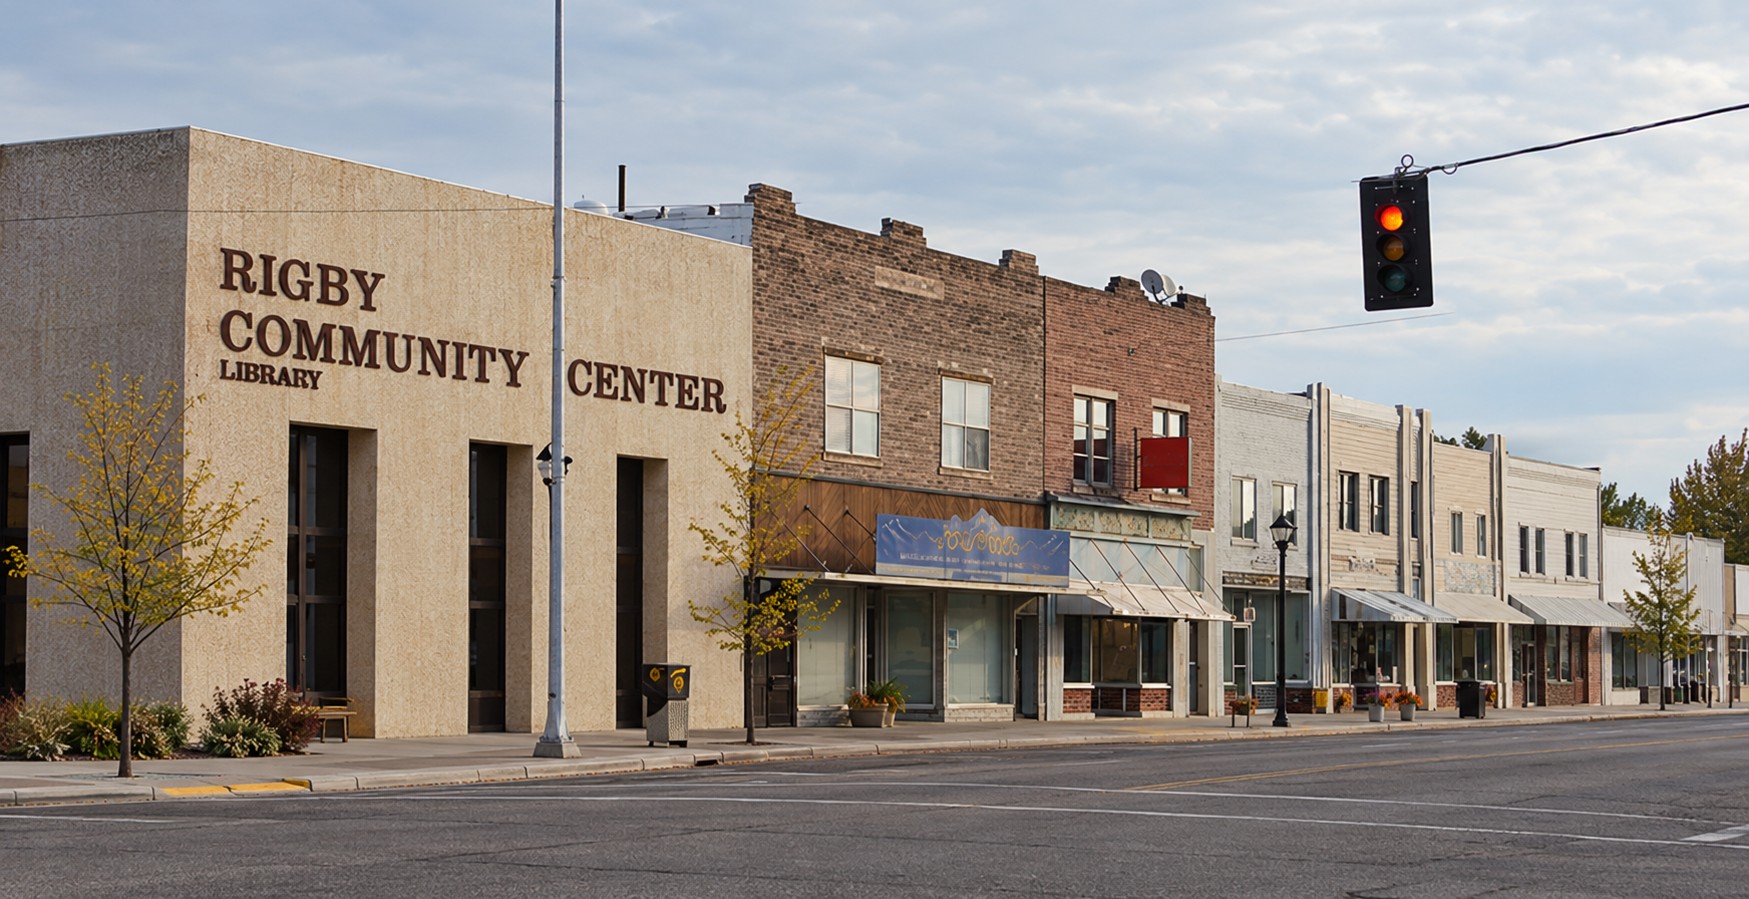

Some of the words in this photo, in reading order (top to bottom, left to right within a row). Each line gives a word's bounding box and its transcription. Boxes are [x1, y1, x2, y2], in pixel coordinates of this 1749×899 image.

[219, 247, 386, 312] RIGBY
[219, 309, 530, 389] COMMUNITY
[567, 358, 727, 414] CENTER
[219, 359, 324, 390] LIBRARY
